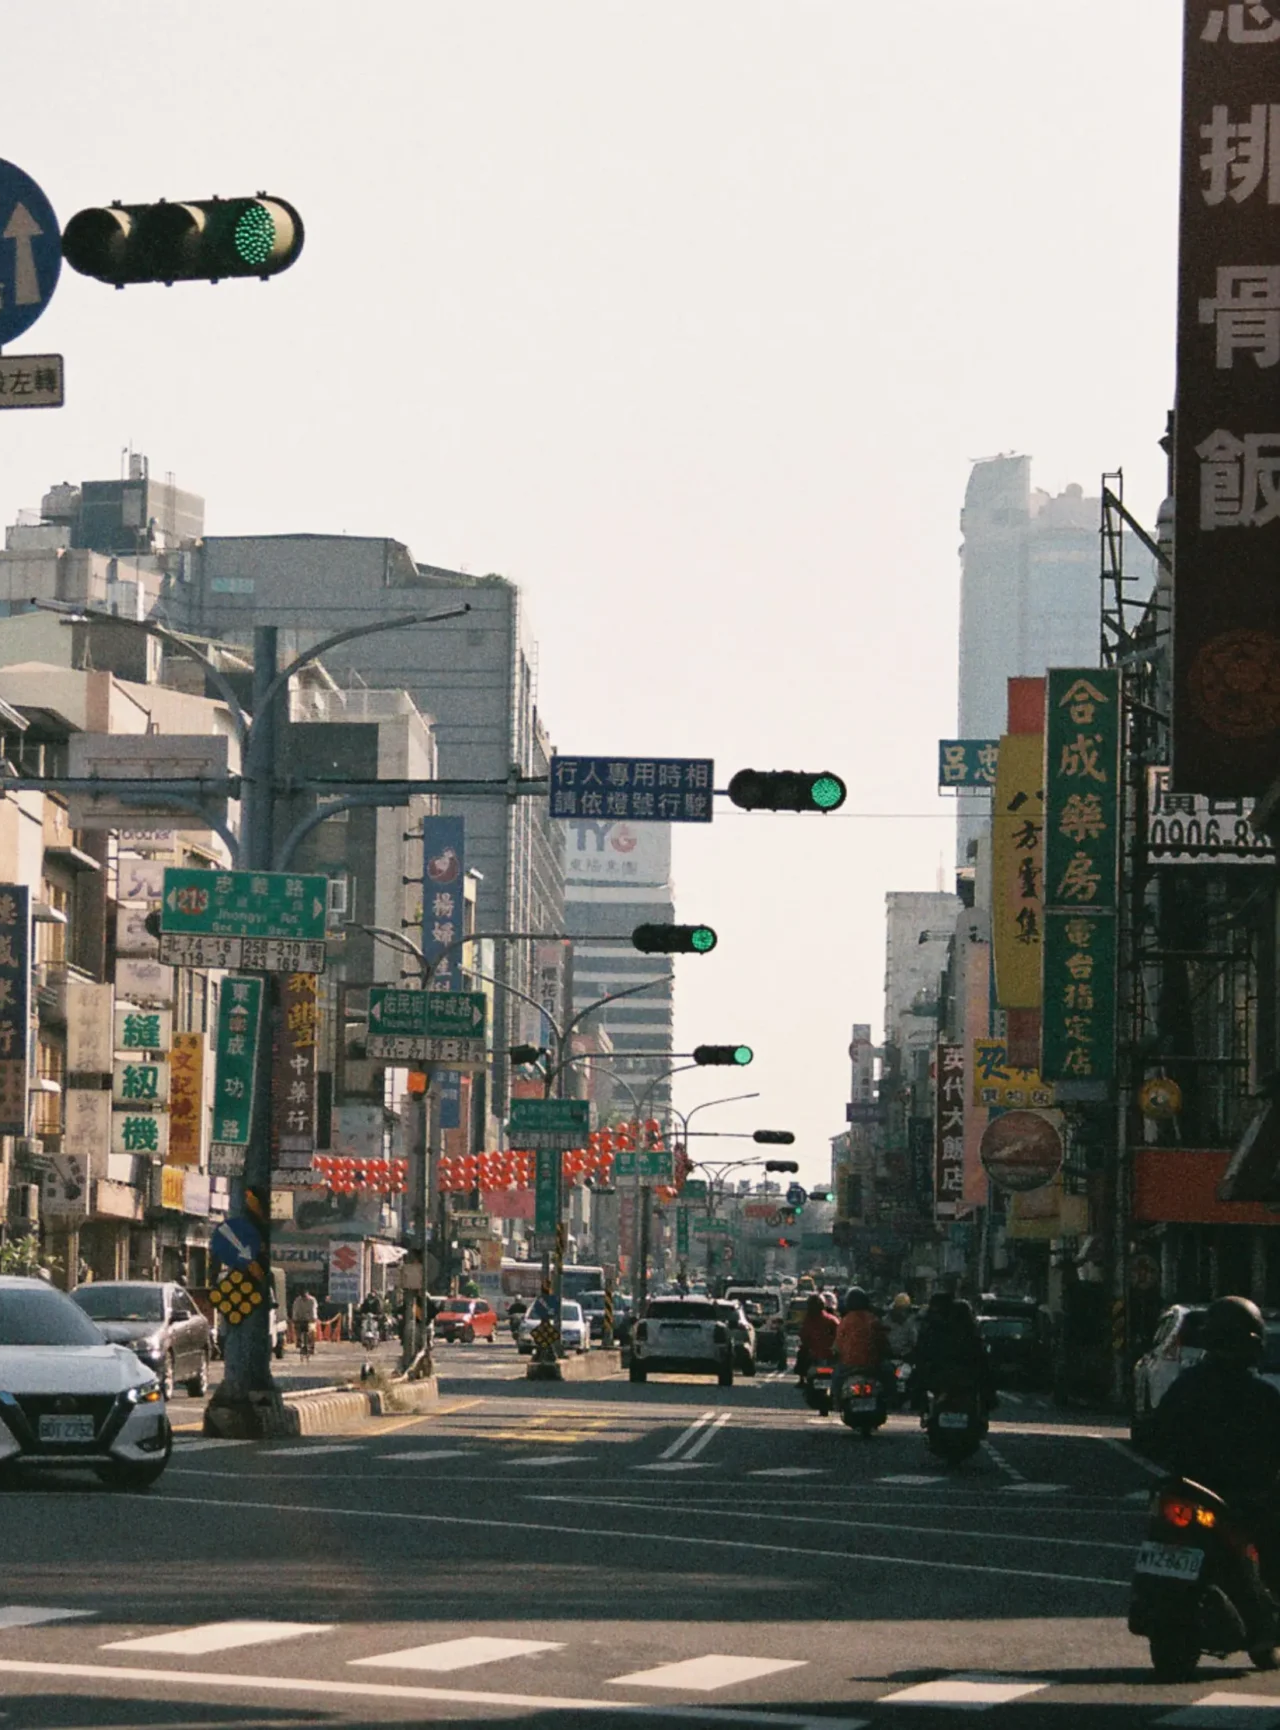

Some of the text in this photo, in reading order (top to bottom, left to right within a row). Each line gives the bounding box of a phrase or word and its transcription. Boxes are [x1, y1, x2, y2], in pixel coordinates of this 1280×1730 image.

[555, 760, 709, 788] 行人專用時相
[1057, 679, 1109, 901] 合成藥房
[122, 1013, 160, 1151] 縫紉機
[221, 1035, 245, 1139] 成功路
[286, 1053, 309, 1133] 中藥行
